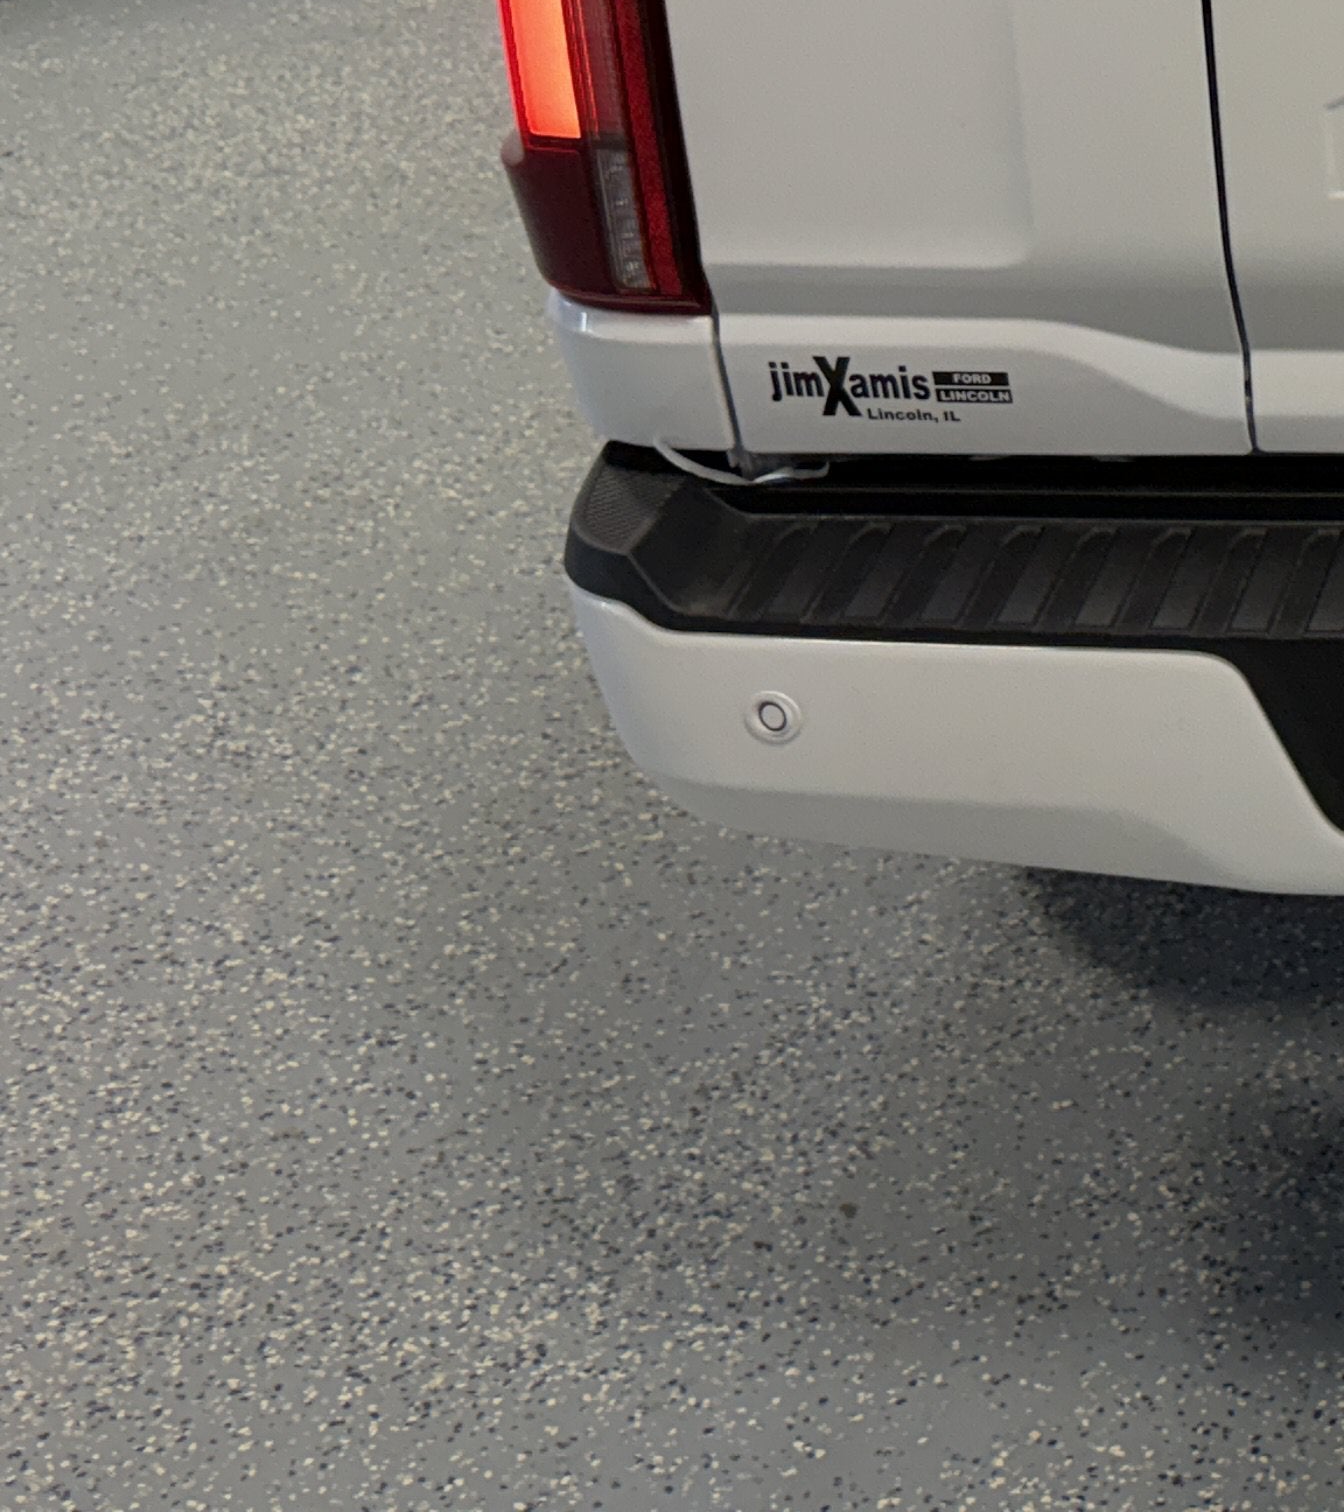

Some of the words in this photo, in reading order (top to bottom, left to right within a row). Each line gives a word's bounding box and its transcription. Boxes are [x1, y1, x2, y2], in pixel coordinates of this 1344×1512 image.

[952, 373, 992, 385] FORD
[938, 389, 1010, 402] LINCOLN
[866, 407, 939, 423] Lincoln,
[943, 411, 961, 422] IL
